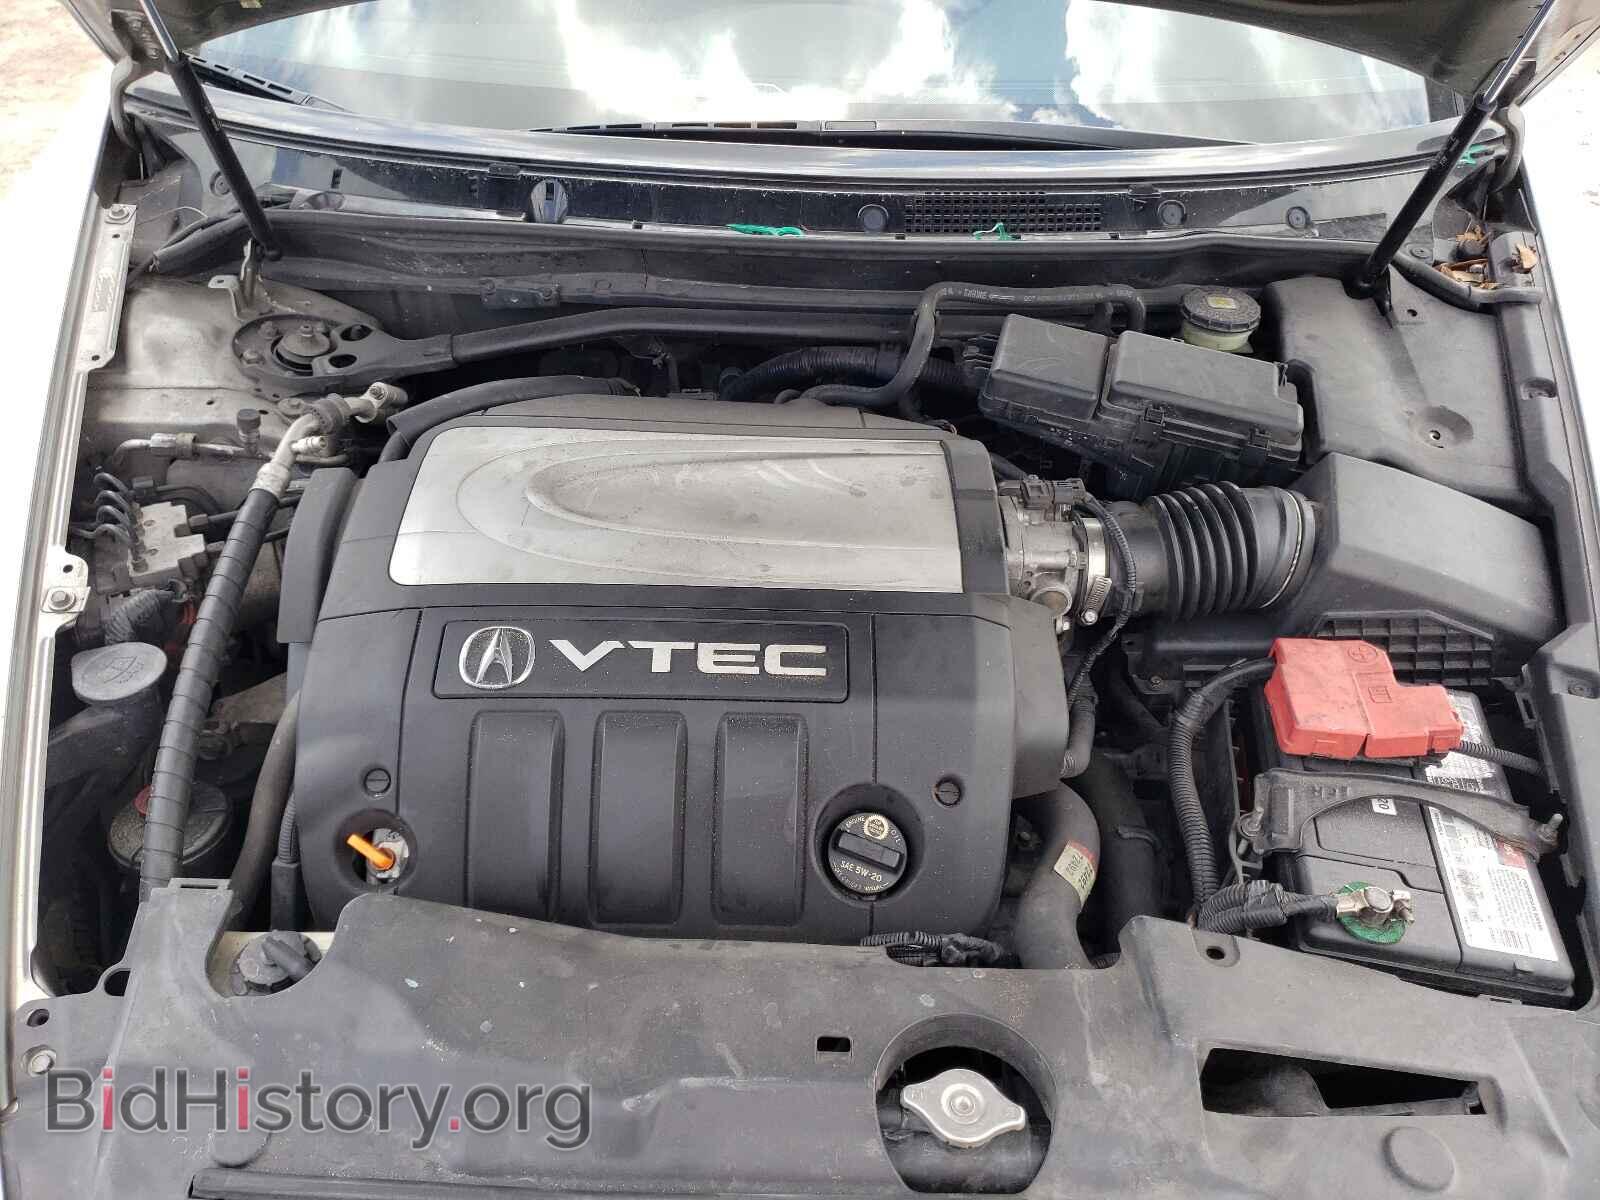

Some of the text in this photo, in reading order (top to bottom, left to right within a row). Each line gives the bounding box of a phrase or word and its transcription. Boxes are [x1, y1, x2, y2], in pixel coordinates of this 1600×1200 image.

[548, 639, 827, 676] VTEC
[840, 860, 854, 872] SAE
[855, 866, 882, 882] 5W-20
